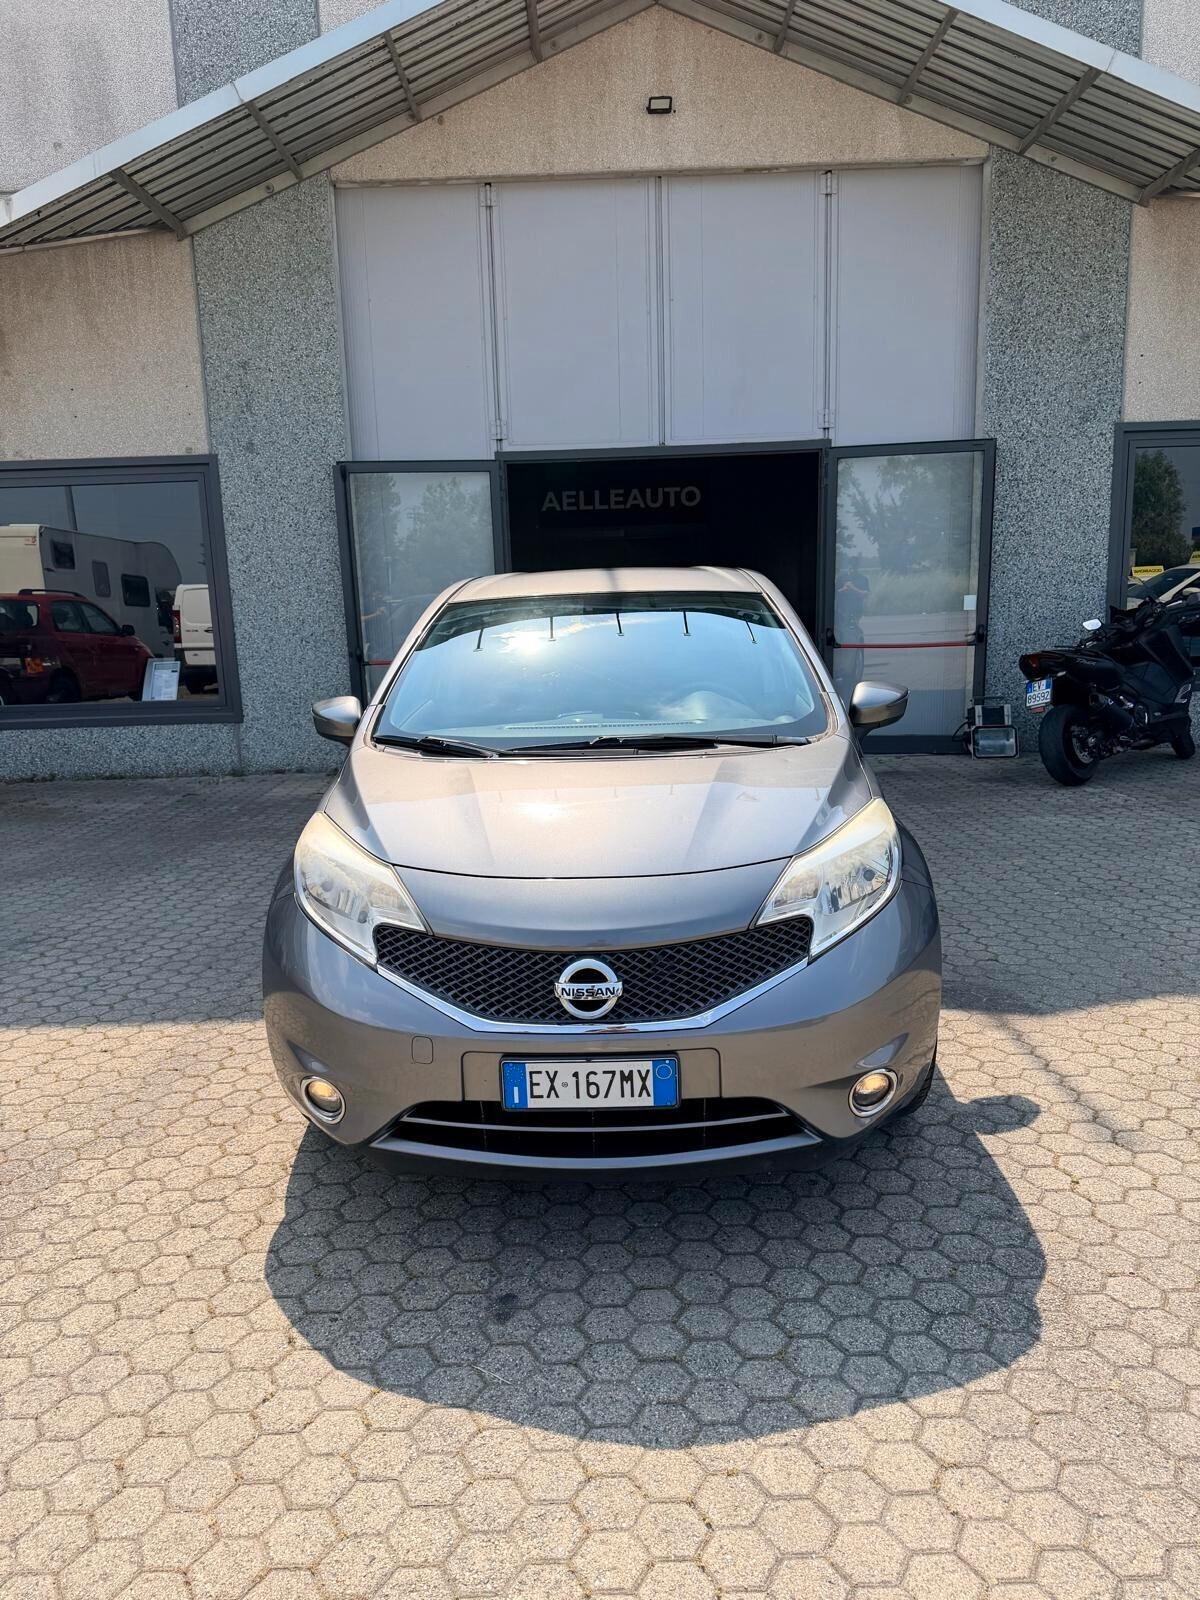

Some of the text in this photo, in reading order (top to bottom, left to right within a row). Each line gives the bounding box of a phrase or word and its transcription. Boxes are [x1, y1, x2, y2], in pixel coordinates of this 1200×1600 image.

[541, 486, 702, 512] AELLEAUTO
[1027, 690, 1050, 704] 89592
[561, 986, 616, 997] NISSAN
